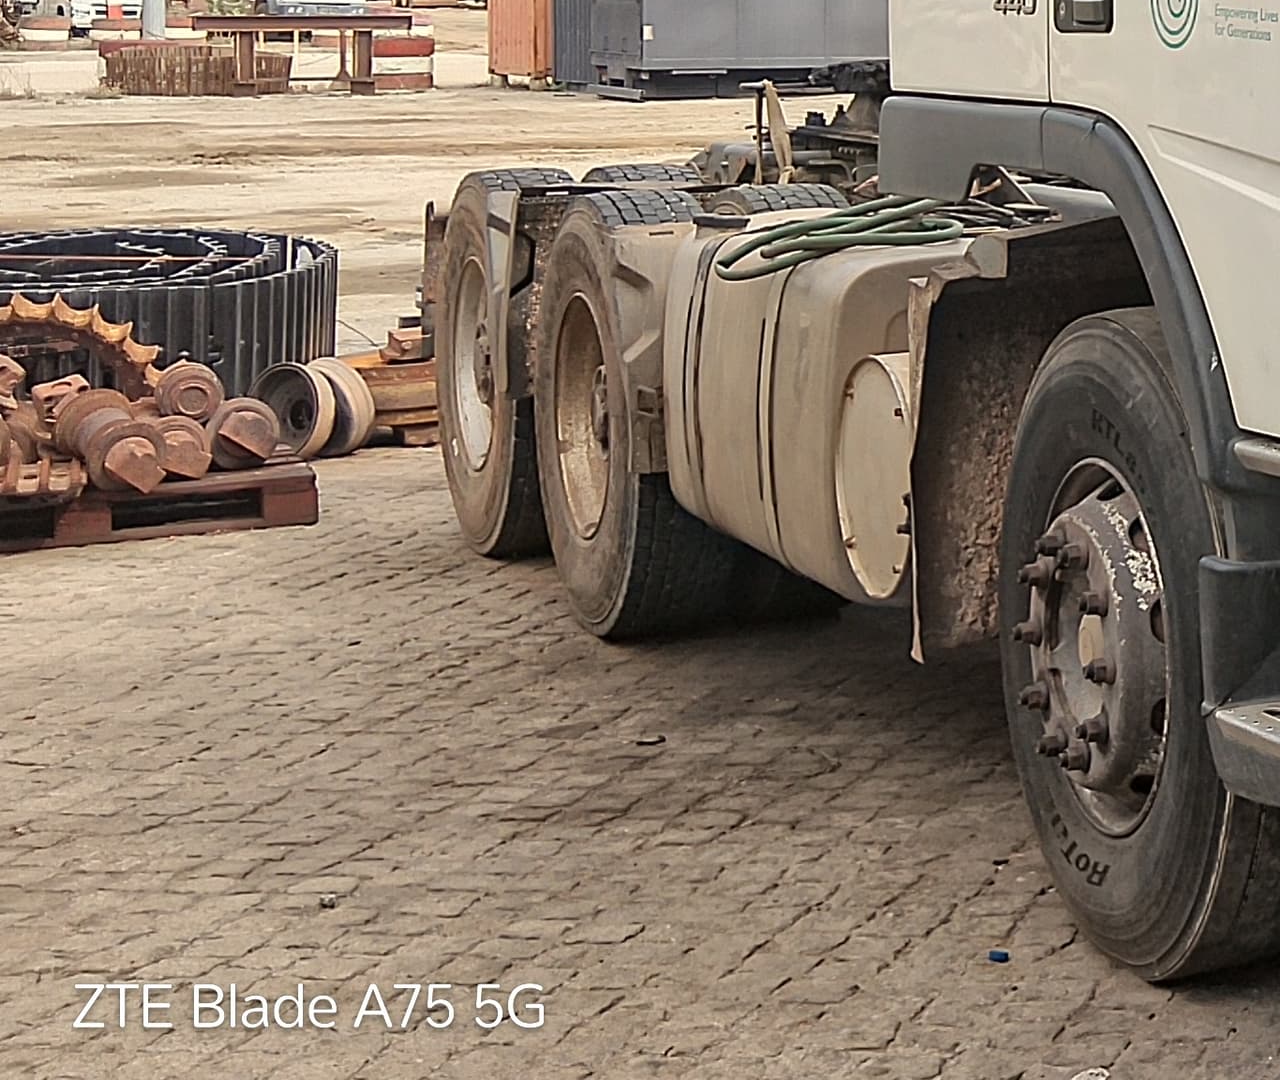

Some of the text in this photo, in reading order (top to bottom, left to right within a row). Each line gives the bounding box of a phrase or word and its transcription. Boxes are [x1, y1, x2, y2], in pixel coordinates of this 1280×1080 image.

[1215, 3, 1279, 23] Empowering Lives
[1227, 23, 1272, 41] Generations
